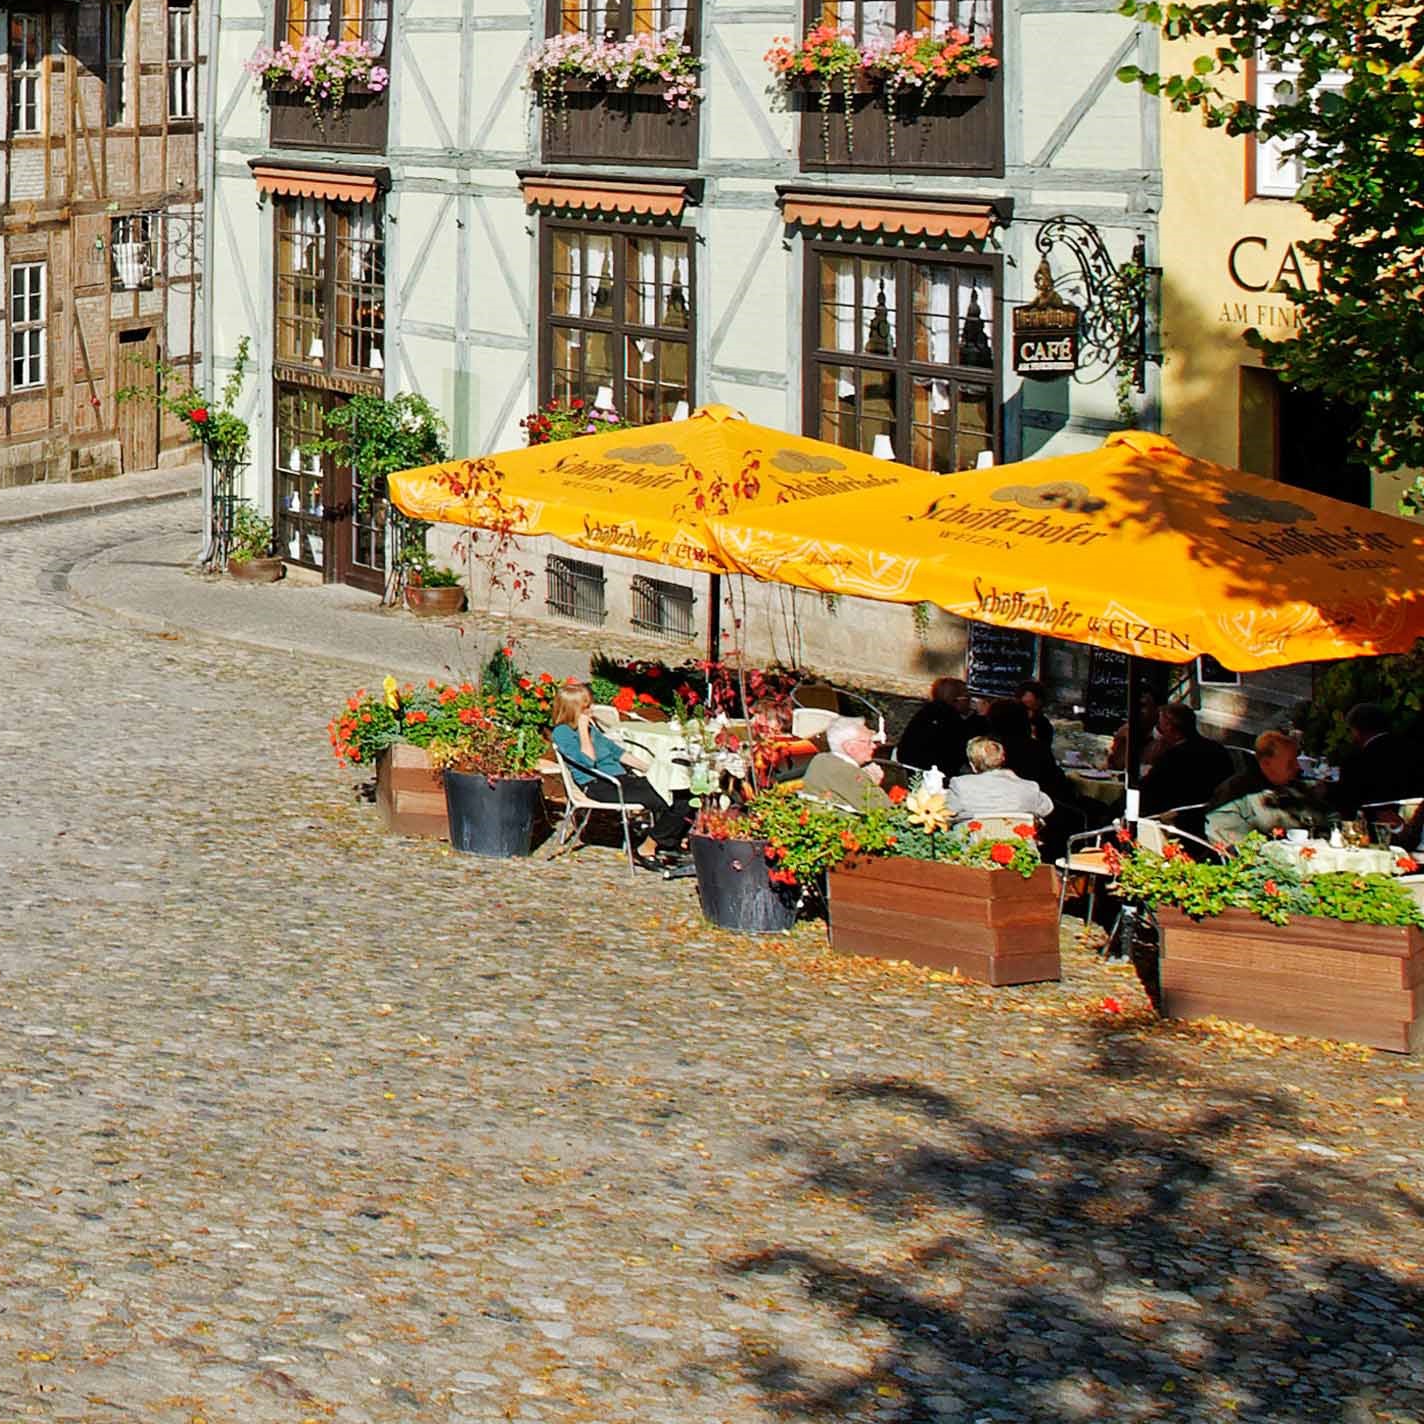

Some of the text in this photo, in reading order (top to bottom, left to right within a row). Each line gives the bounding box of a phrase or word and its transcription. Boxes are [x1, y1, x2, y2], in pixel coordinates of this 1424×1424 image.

[1219, 303, 1304, 328] AM FINK
[1020, 337, 1072, 361] CAFÉ
[539, 454, 684, 488] Schöfferhofer
[904, 494, 1107, 545] Schöfferhofer
[939, 530, 1020, 550] WEIZEN
[971, 576, 1192, 652] Schöfferhofer WEIZEN
